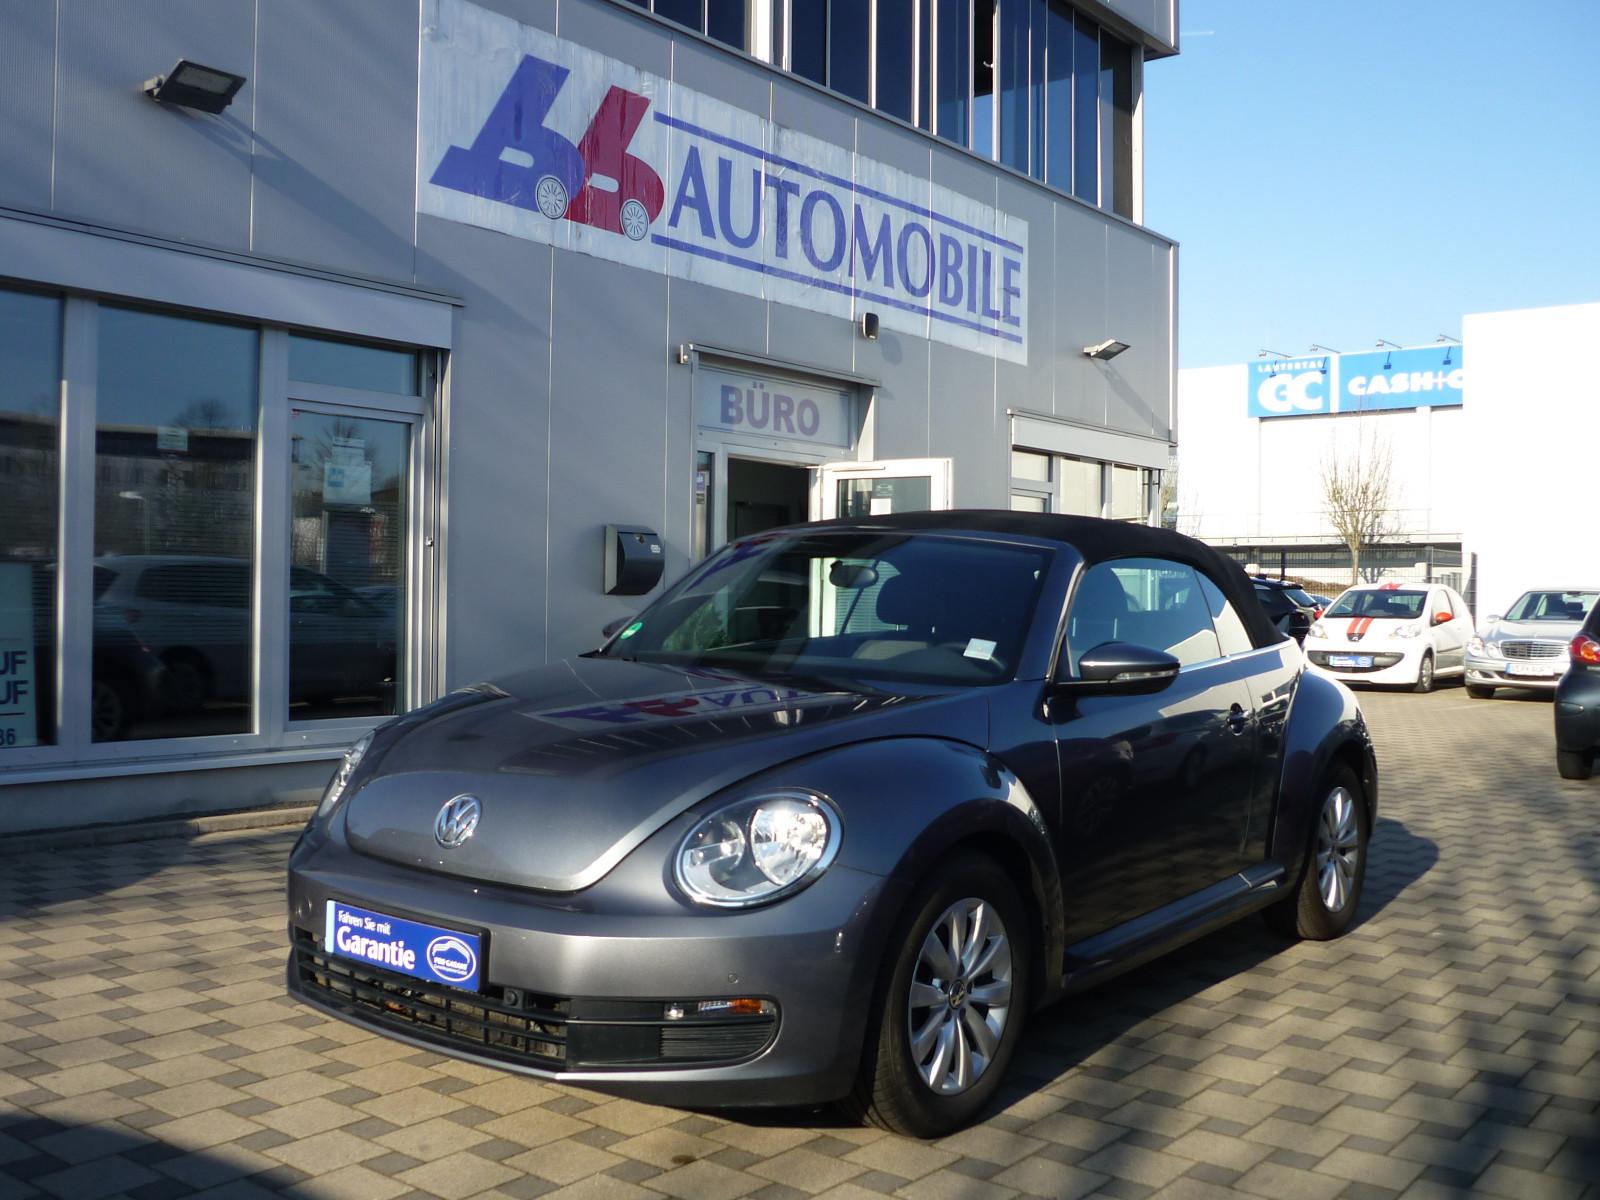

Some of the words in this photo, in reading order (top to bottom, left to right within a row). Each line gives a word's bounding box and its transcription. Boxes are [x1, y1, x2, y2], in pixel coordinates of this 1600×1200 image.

[668, 145, 1021, 328] AUTOMOBILE
[719, 381, 820, 437] BÜRO
[336, 925, 416, 970] Garantie
[338, 910, 364, 928] Fahren
[364, 917, 376, 932] Sie
[376, 922, 391, 936] mit
